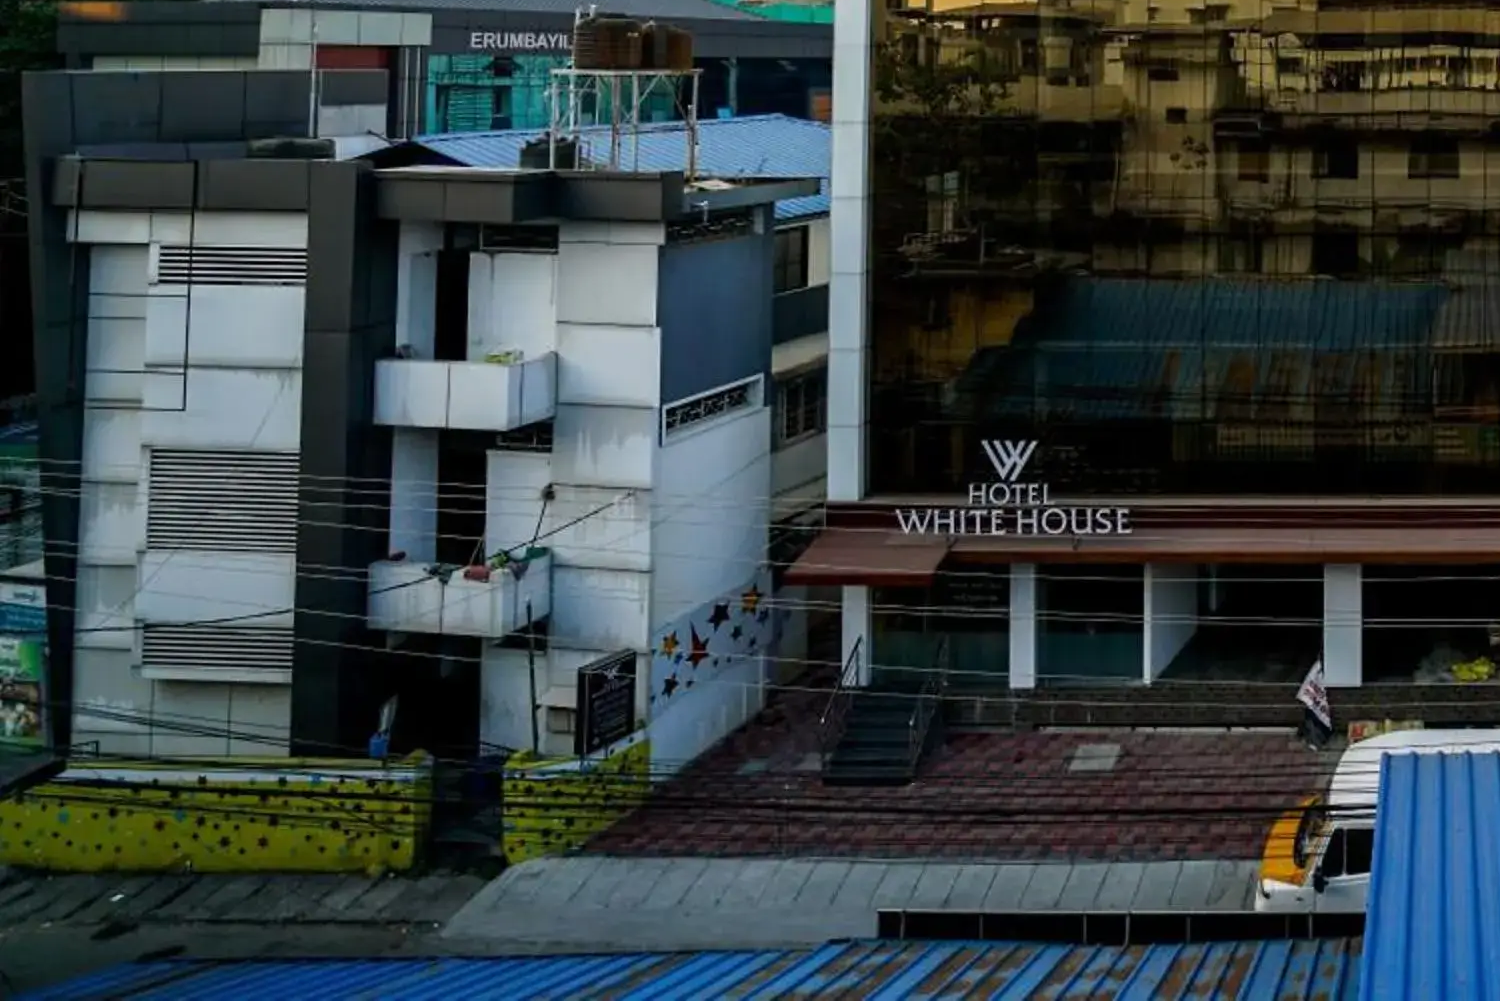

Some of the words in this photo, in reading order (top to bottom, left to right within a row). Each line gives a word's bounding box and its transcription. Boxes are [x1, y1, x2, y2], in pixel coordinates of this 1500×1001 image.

[968, 483, 1054, 505] HOTEL
[895, 508, 1006, 535] WHITE
[1016, 508, 1133, 535] HOUSE
